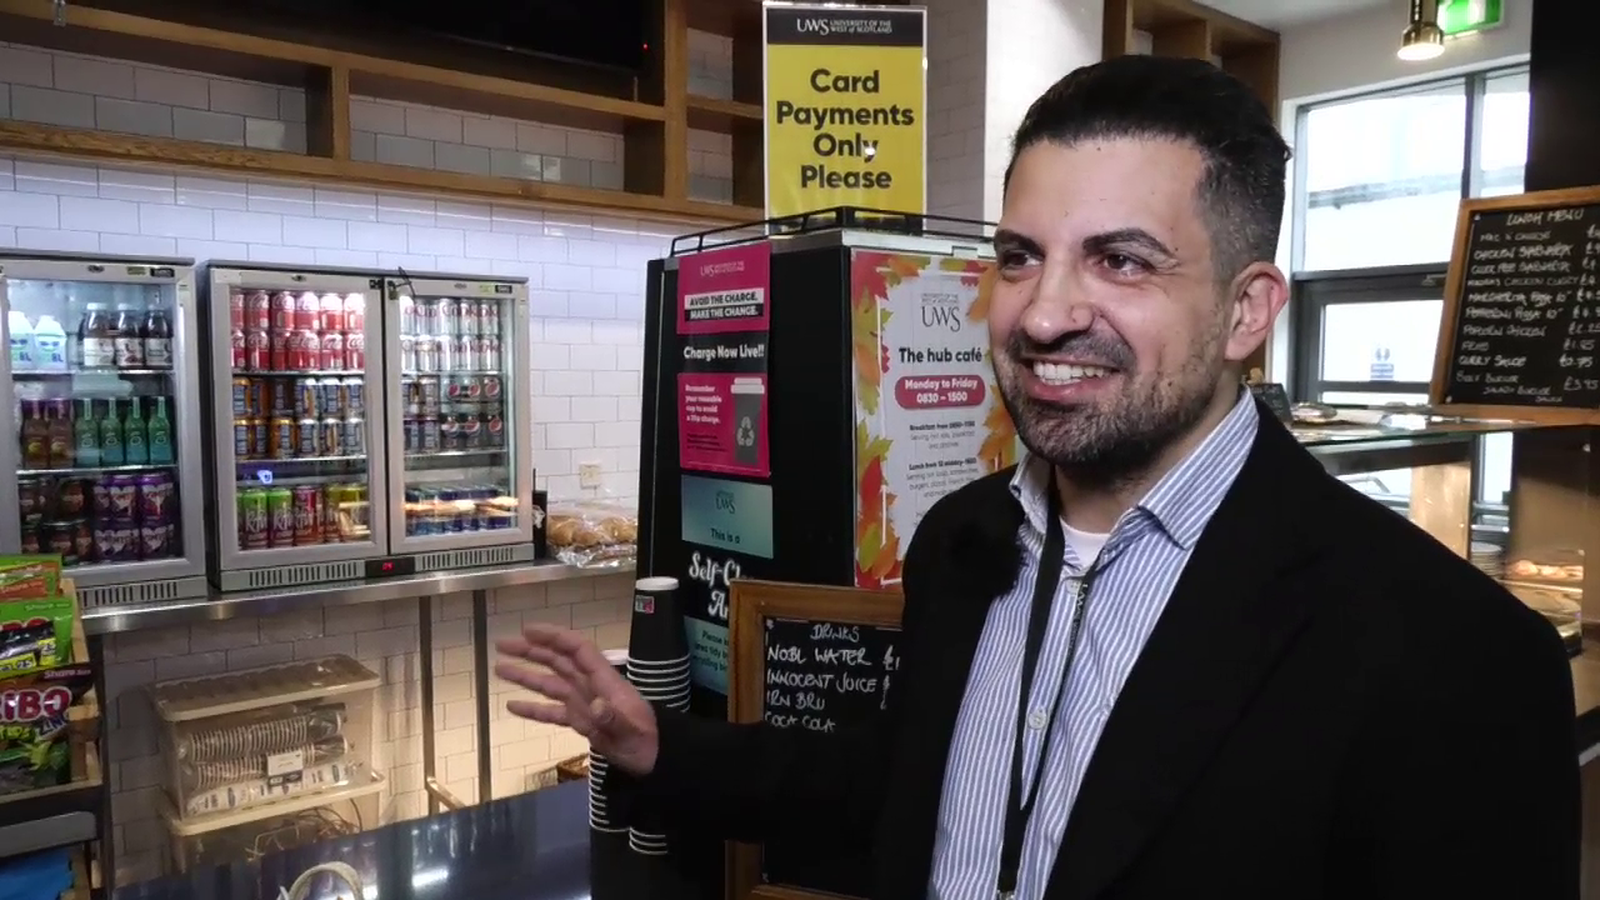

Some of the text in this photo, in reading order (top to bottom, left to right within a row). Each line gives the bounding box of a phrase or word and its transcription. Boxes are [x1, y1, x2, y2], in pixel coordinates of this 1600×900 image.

[797, 18, 829, 35] UWS
[810, 68, 880, 93] Card
[776, 100, 914, 131] Payments
[813, 132, 878, 163] Only
[801, 164, 892, 189] Please
[1506, 208, 1584, 226] LUNCH MENU
[1474, 248, 1515, 261] CHICKEN
[1518, 243, 1574, 261] SANDWICH
[1518, 260, 1570, 274] SANDWICH
[1504, 278, 1544, 287] CHICKEN
[690, 291, 758, 306] AVOID THE CHARGE.
[690, 306, 758, 320] MAKE THE CHANGE.
[921, 305, 961, 332] UWS
[1463, 324, 1503, 336] POPCORN
[1507, 324, 1547, 337] CHICKEN
[683, 344, 764, 361] Charge Now Live!!
[899, 346, 982, 363] The hub café
[1459, 355, 1491, 366] CURRY
[904, 377, 978, 392] Monday to Friday
[916, 392, 939, 403] 0830
[947, 391, 967, 402] 1500
[716, 498, 735, 514] UWS
[711, 528, 740, 544] This is a
[810, 623, 860, 643] DRINKS
[766, 644, 807, 665] NOBL
[815, 647, 872, 666] WATER
[766, 668, 834, 690] INNOCENT
[836, 672, 878, 693] JUICE
[766, 690, 825, 710] IRN BRU
[764, 711, 836, 733] COCA COLA
